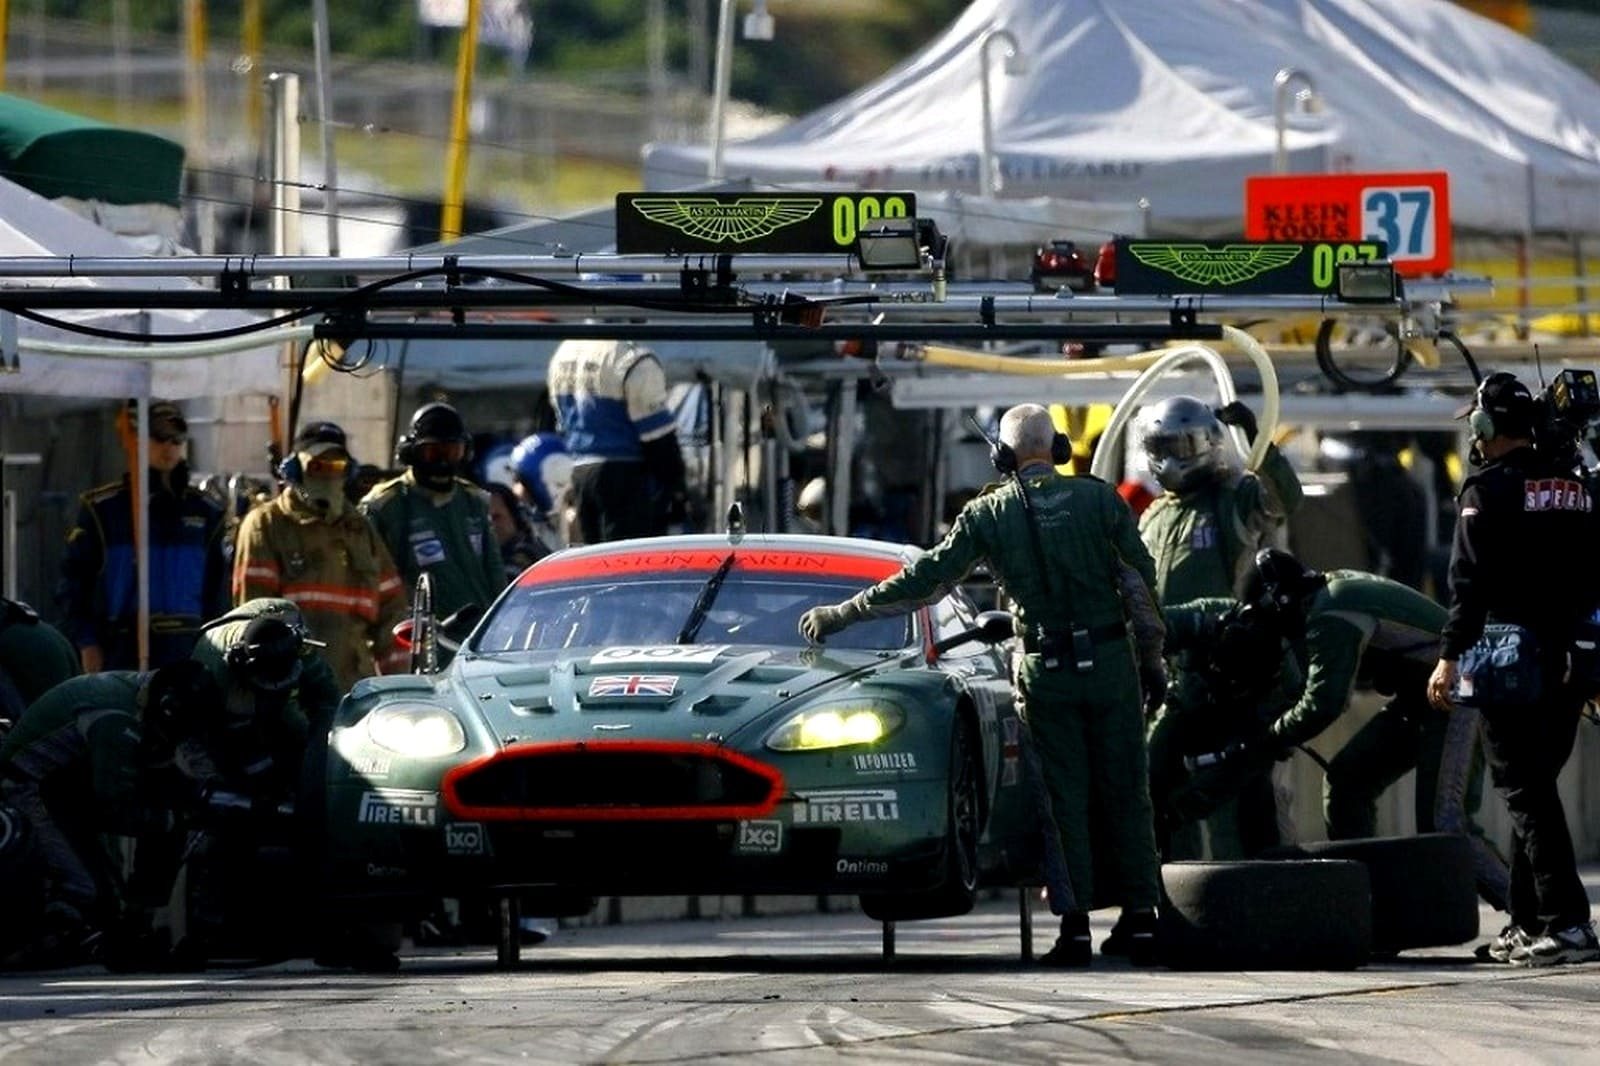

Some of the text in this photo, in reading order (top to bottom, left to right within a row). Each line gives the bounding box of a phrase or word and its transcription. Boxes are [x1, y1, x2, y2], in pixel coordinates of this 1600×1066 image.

[1264, 203, 1348, 222] KLEIN
[1264, 223, 1348, 239] TOOLS
[1366, 191, 1431, 257] 37
[588, 554, 694, 569] ASTON
[853, 753, 916, 769] INFONIZER
[359, 791, 438, 825] PIRELLI
[793, 789, 898, 822] PIRELLI
[836, 859, 888, 873] Ontime
